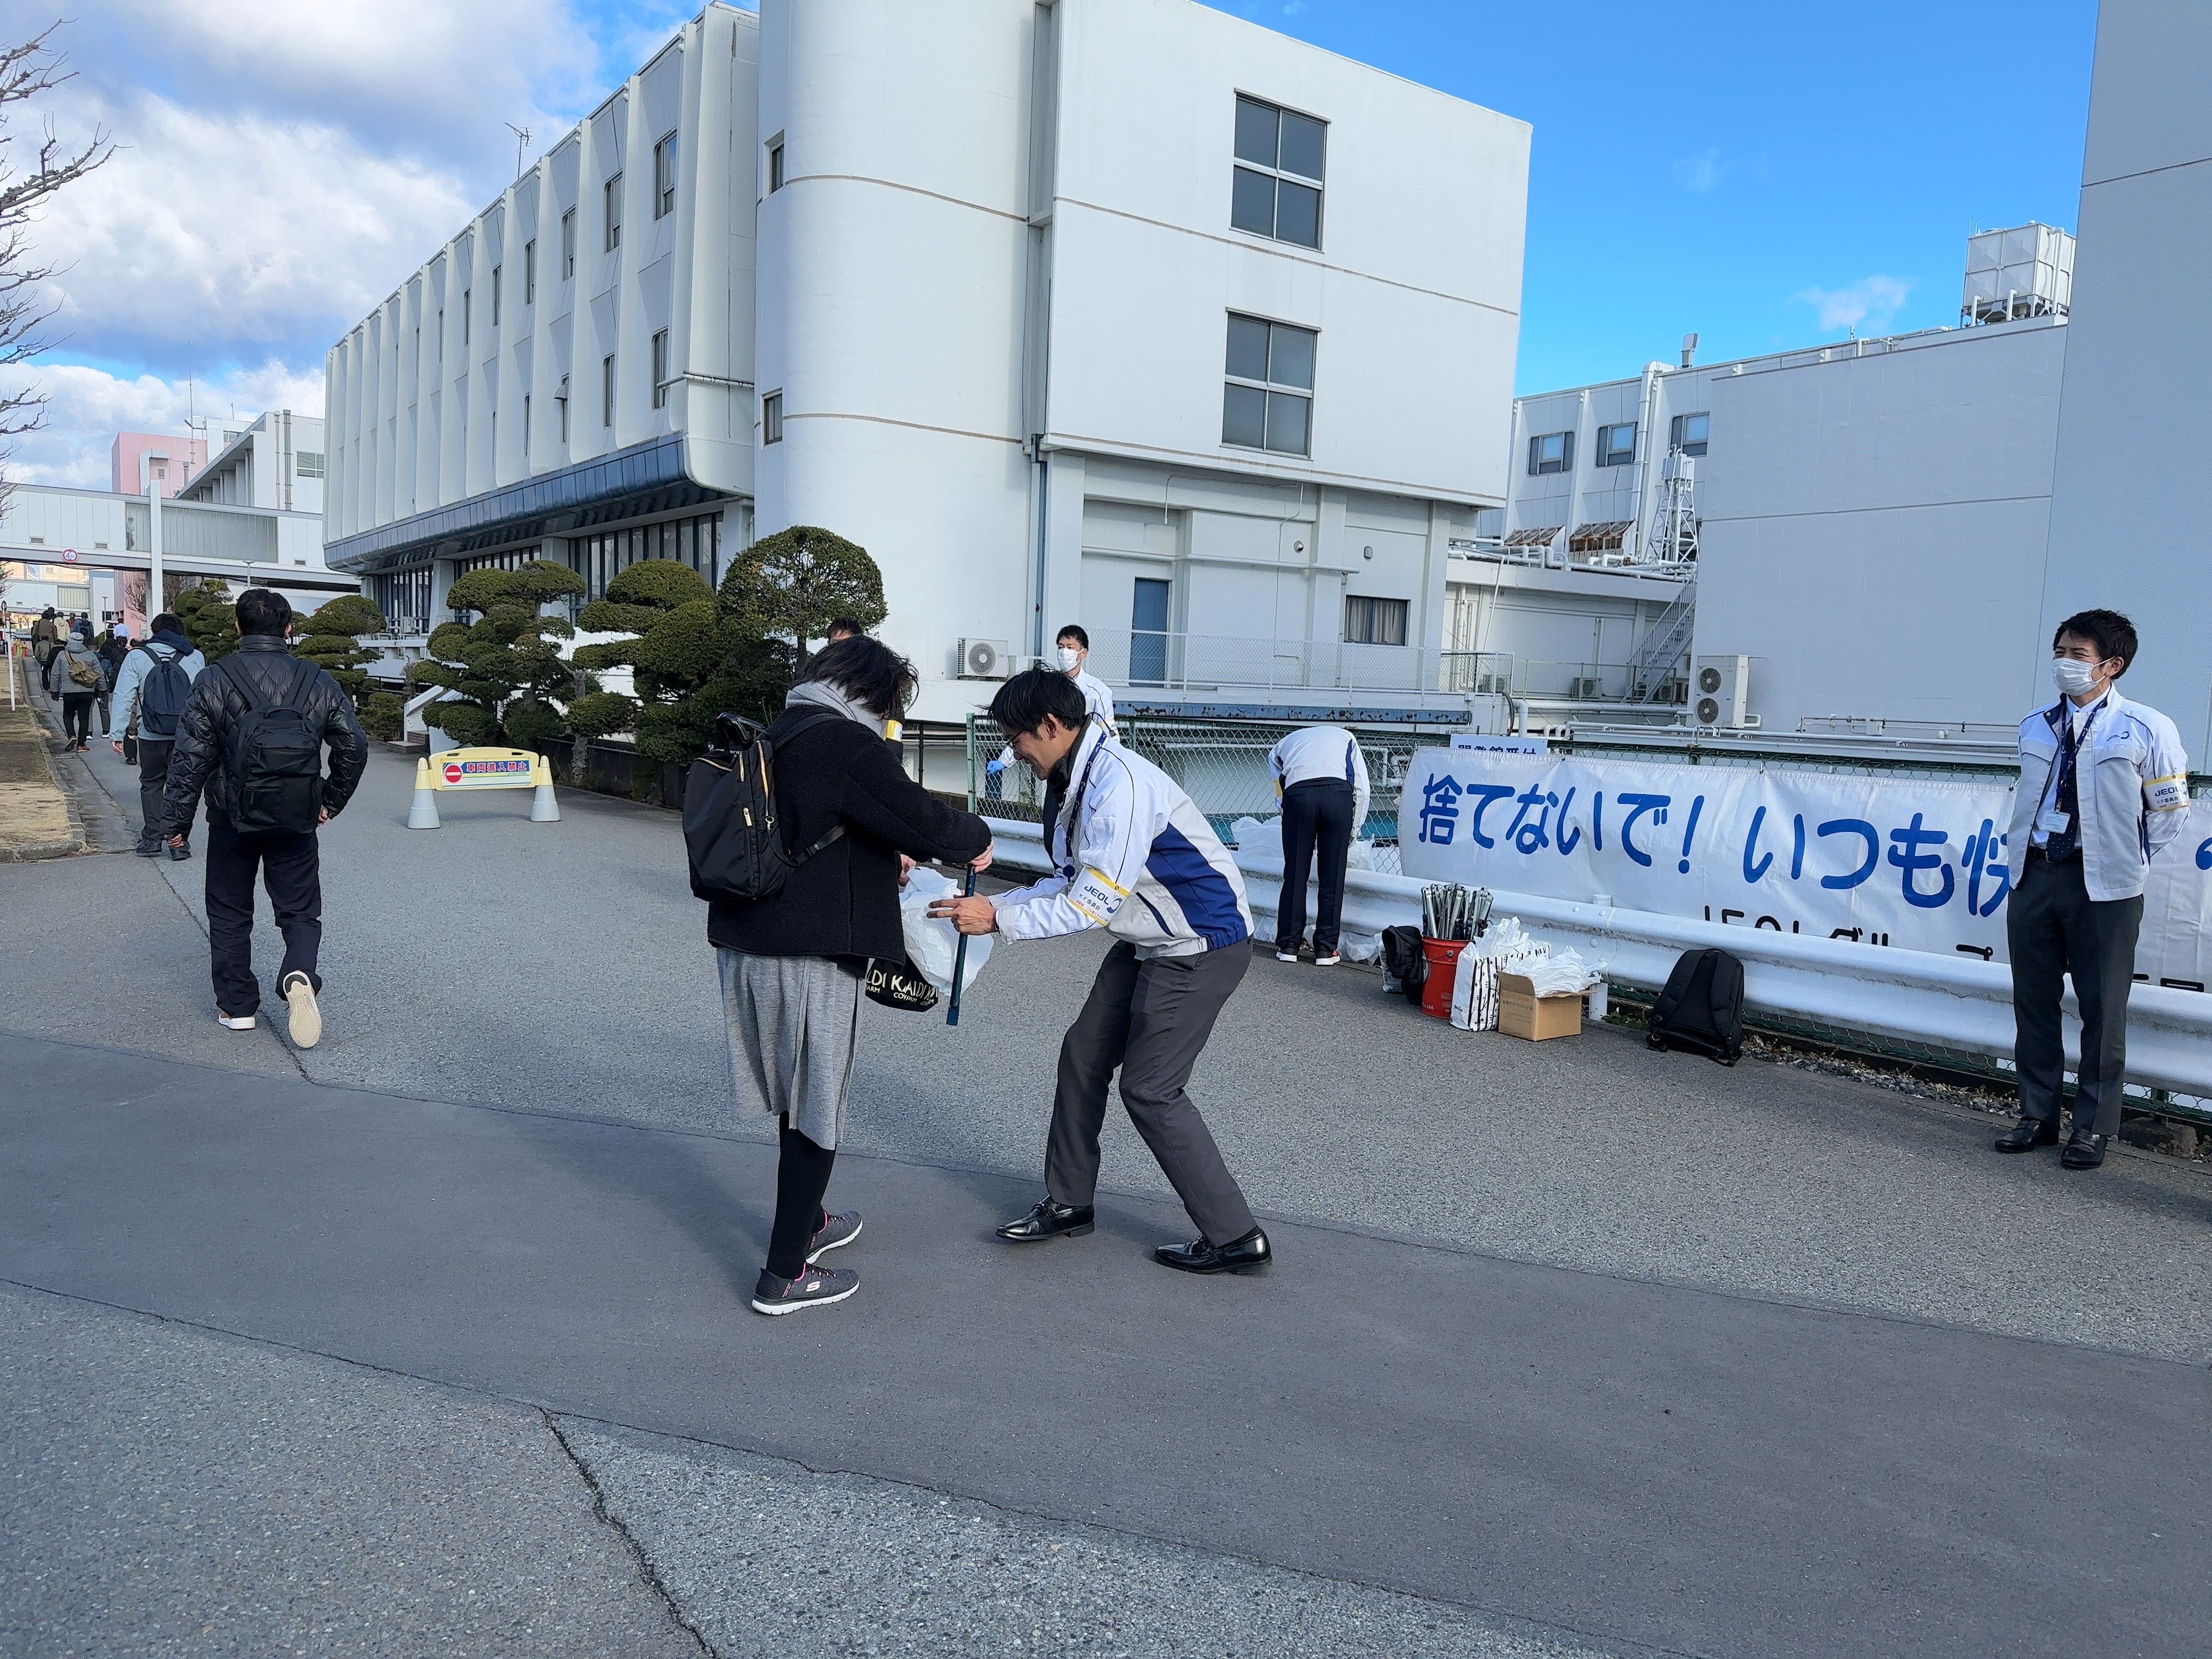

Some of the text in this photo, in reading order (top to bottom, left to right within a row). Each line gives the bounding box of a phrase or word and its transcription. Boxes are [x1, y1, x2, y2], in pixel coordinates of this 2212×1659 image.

[467, 762, 527, 772] 車両進入禁止
[2154, 786, 2182, 797] JEOL
[1418, 772, 1705, 874] 捨てないで!
[1084, 885, 1109, 905] JEOL
